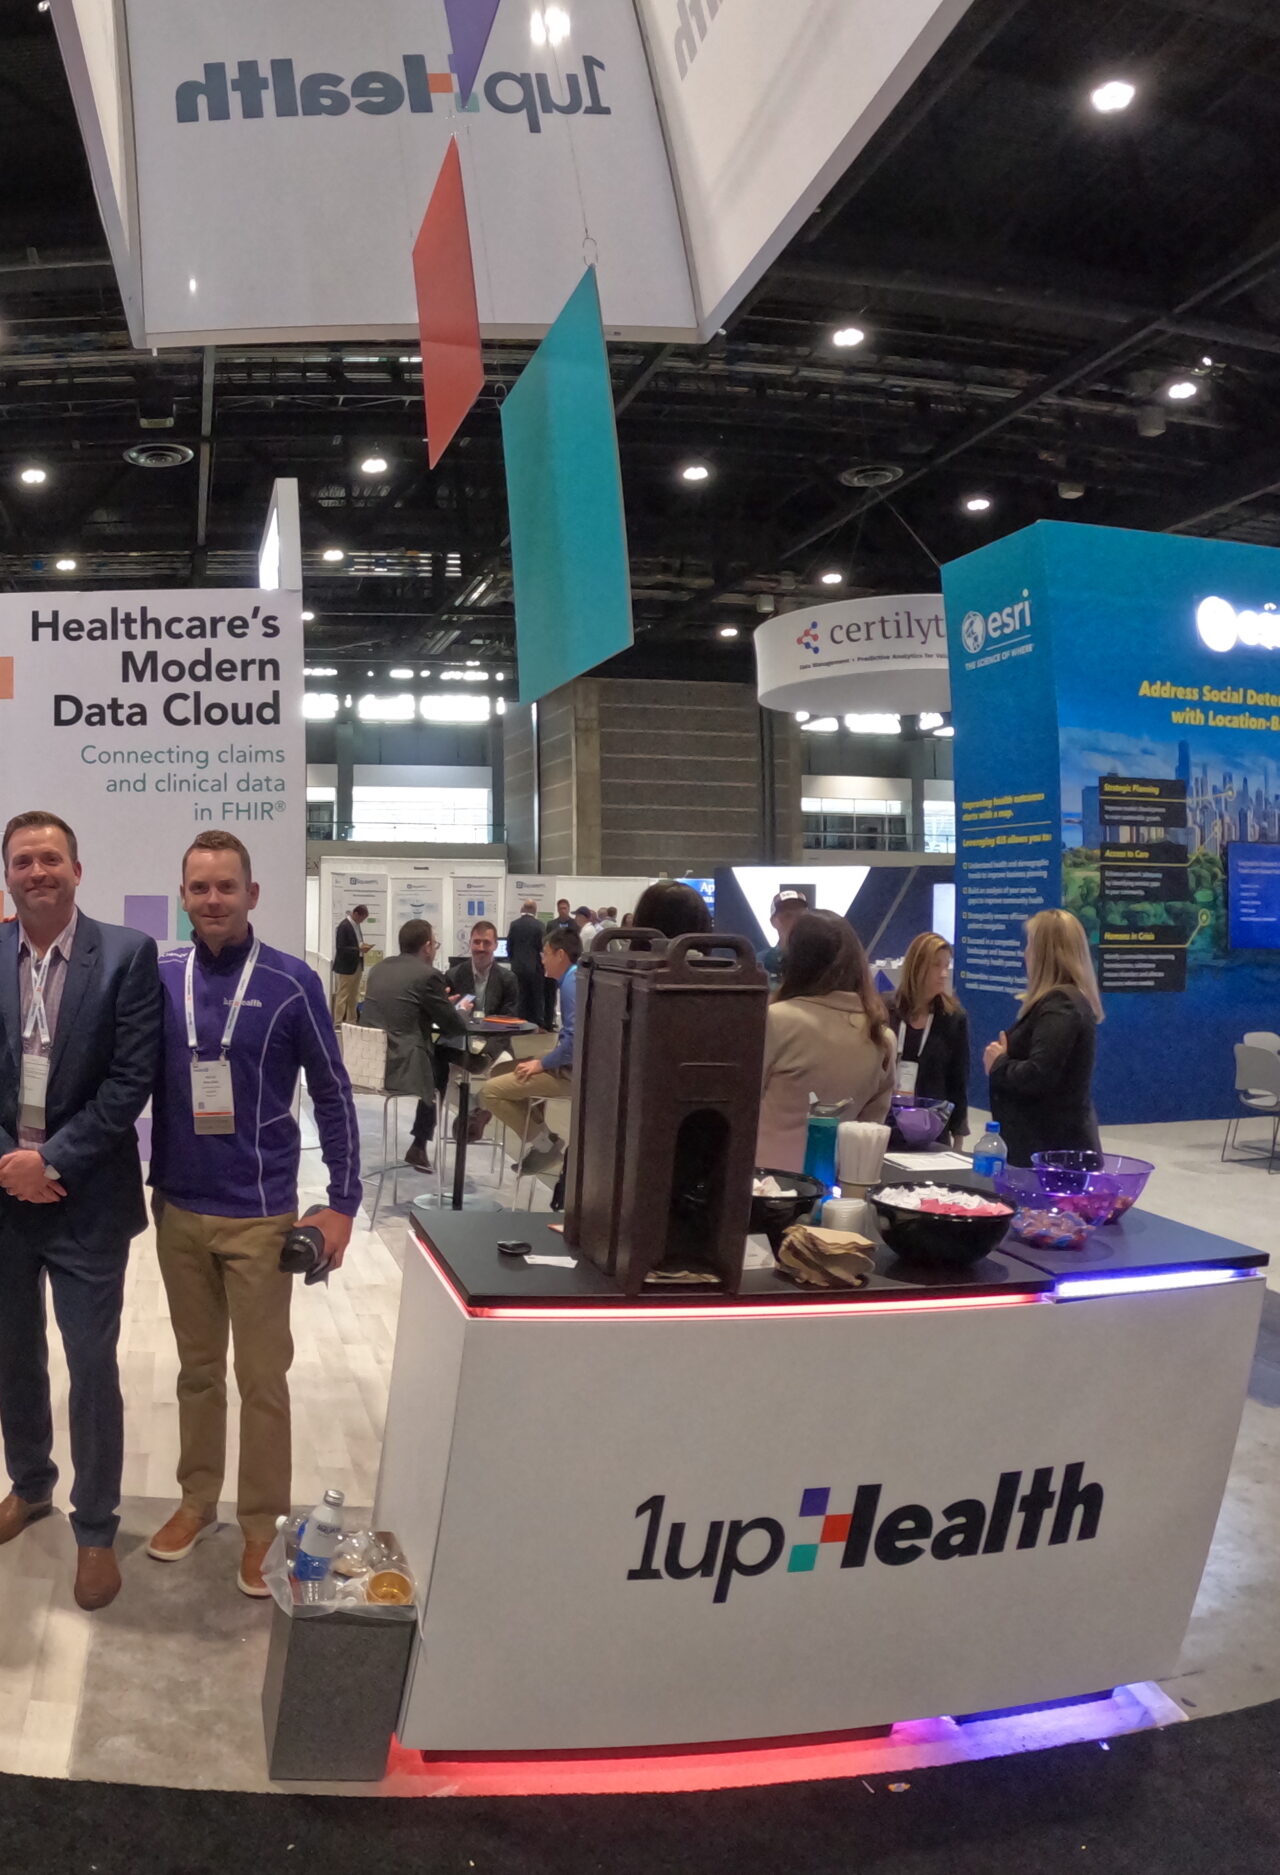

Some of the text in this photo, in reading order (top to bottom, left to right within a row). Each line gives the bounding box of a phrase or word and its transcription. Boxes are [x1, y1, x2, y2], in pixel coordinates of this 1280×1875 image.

[31, 606, 281, 642] Healthcare's
[987, 588, 1032, 638] esri
[830, 611, 945, 645] certilyt
[121, 648, 280, 683] Modern
[1138, 680, 1199, 700] Address
[1202, 685, 1243, 704] Social
[53, 690, 280, 727] Data Cloud
[1171, 707, 1205, 725] with
[81, 744, 285, 769] Connecting claims
[106, 773, 285, 792] and clinical data
[194, 803, 212, 820] in
